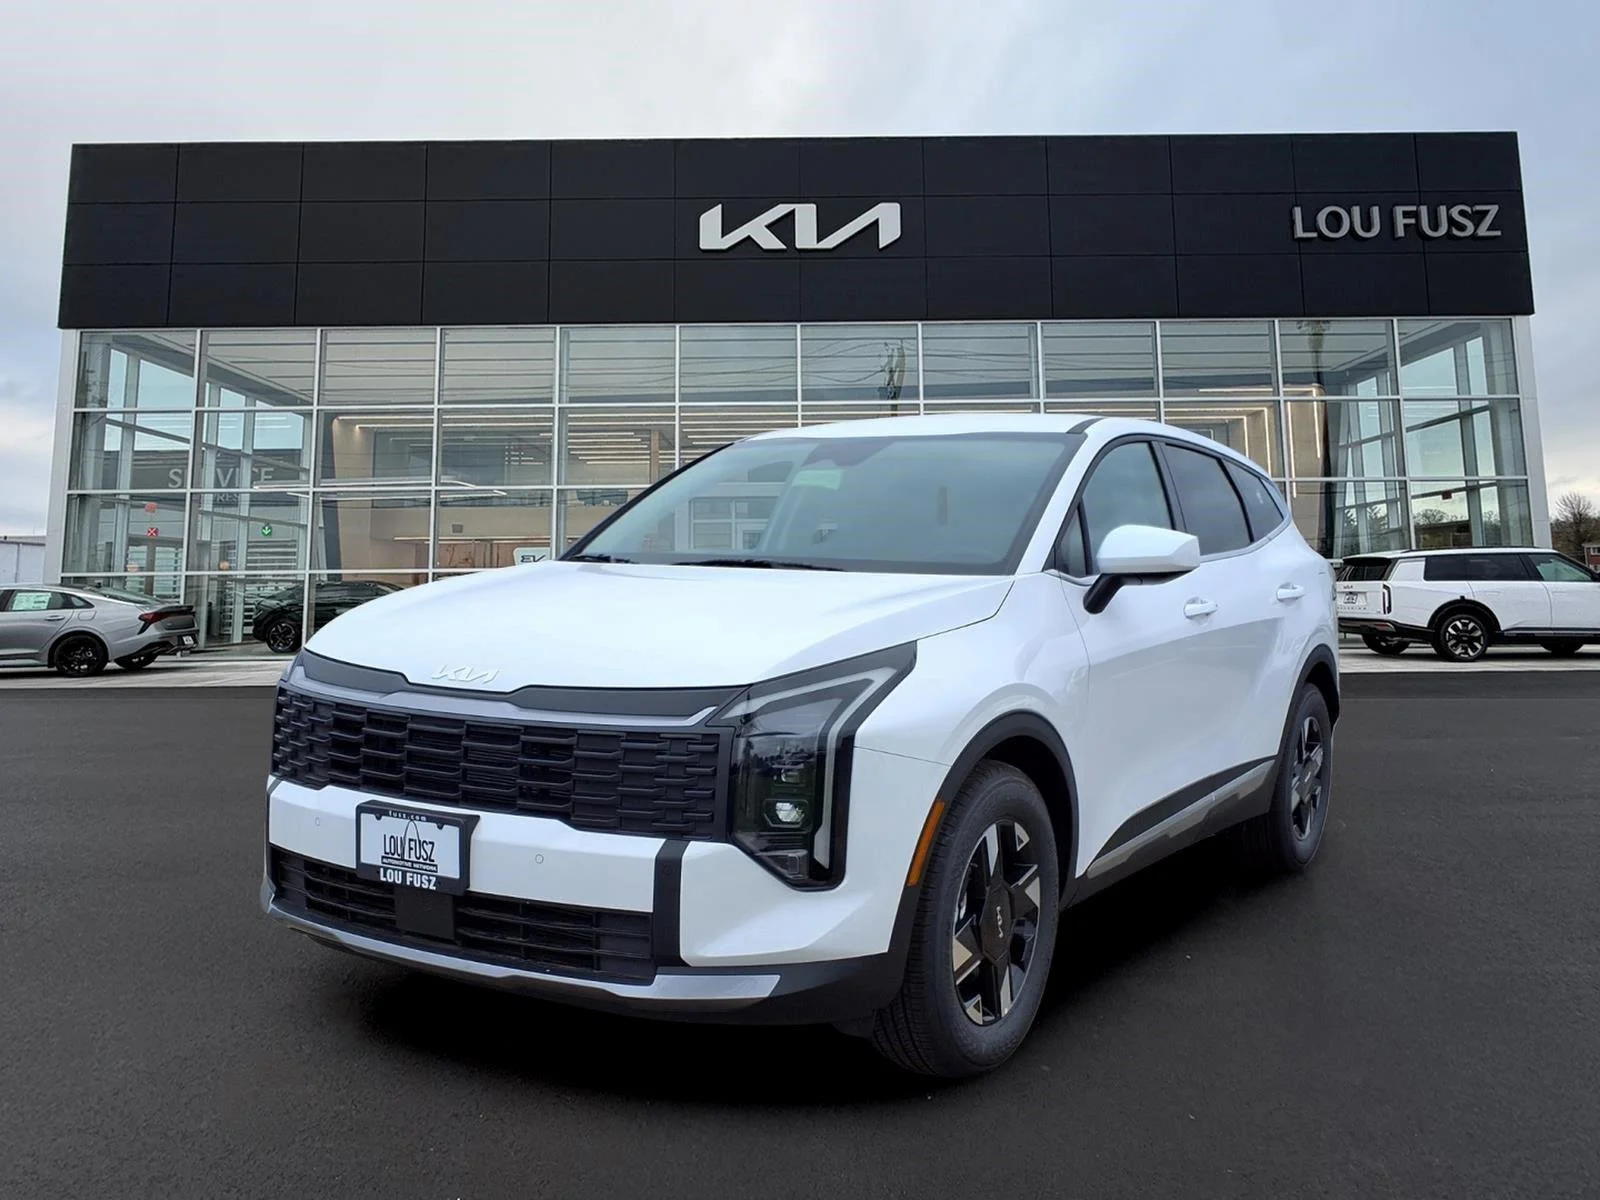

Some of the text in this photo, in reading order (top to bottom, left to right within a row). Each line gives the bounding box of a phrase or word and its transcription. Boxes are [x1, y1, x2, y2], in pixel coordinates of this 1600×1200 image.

[699, 202, 901, 250] KIA
[1292, 204, 1502, 239] LOU FUSZ
[384, 834, 435, 863] LOU FUSZ
[380, 867, 436, 890] LOU FUSZ
